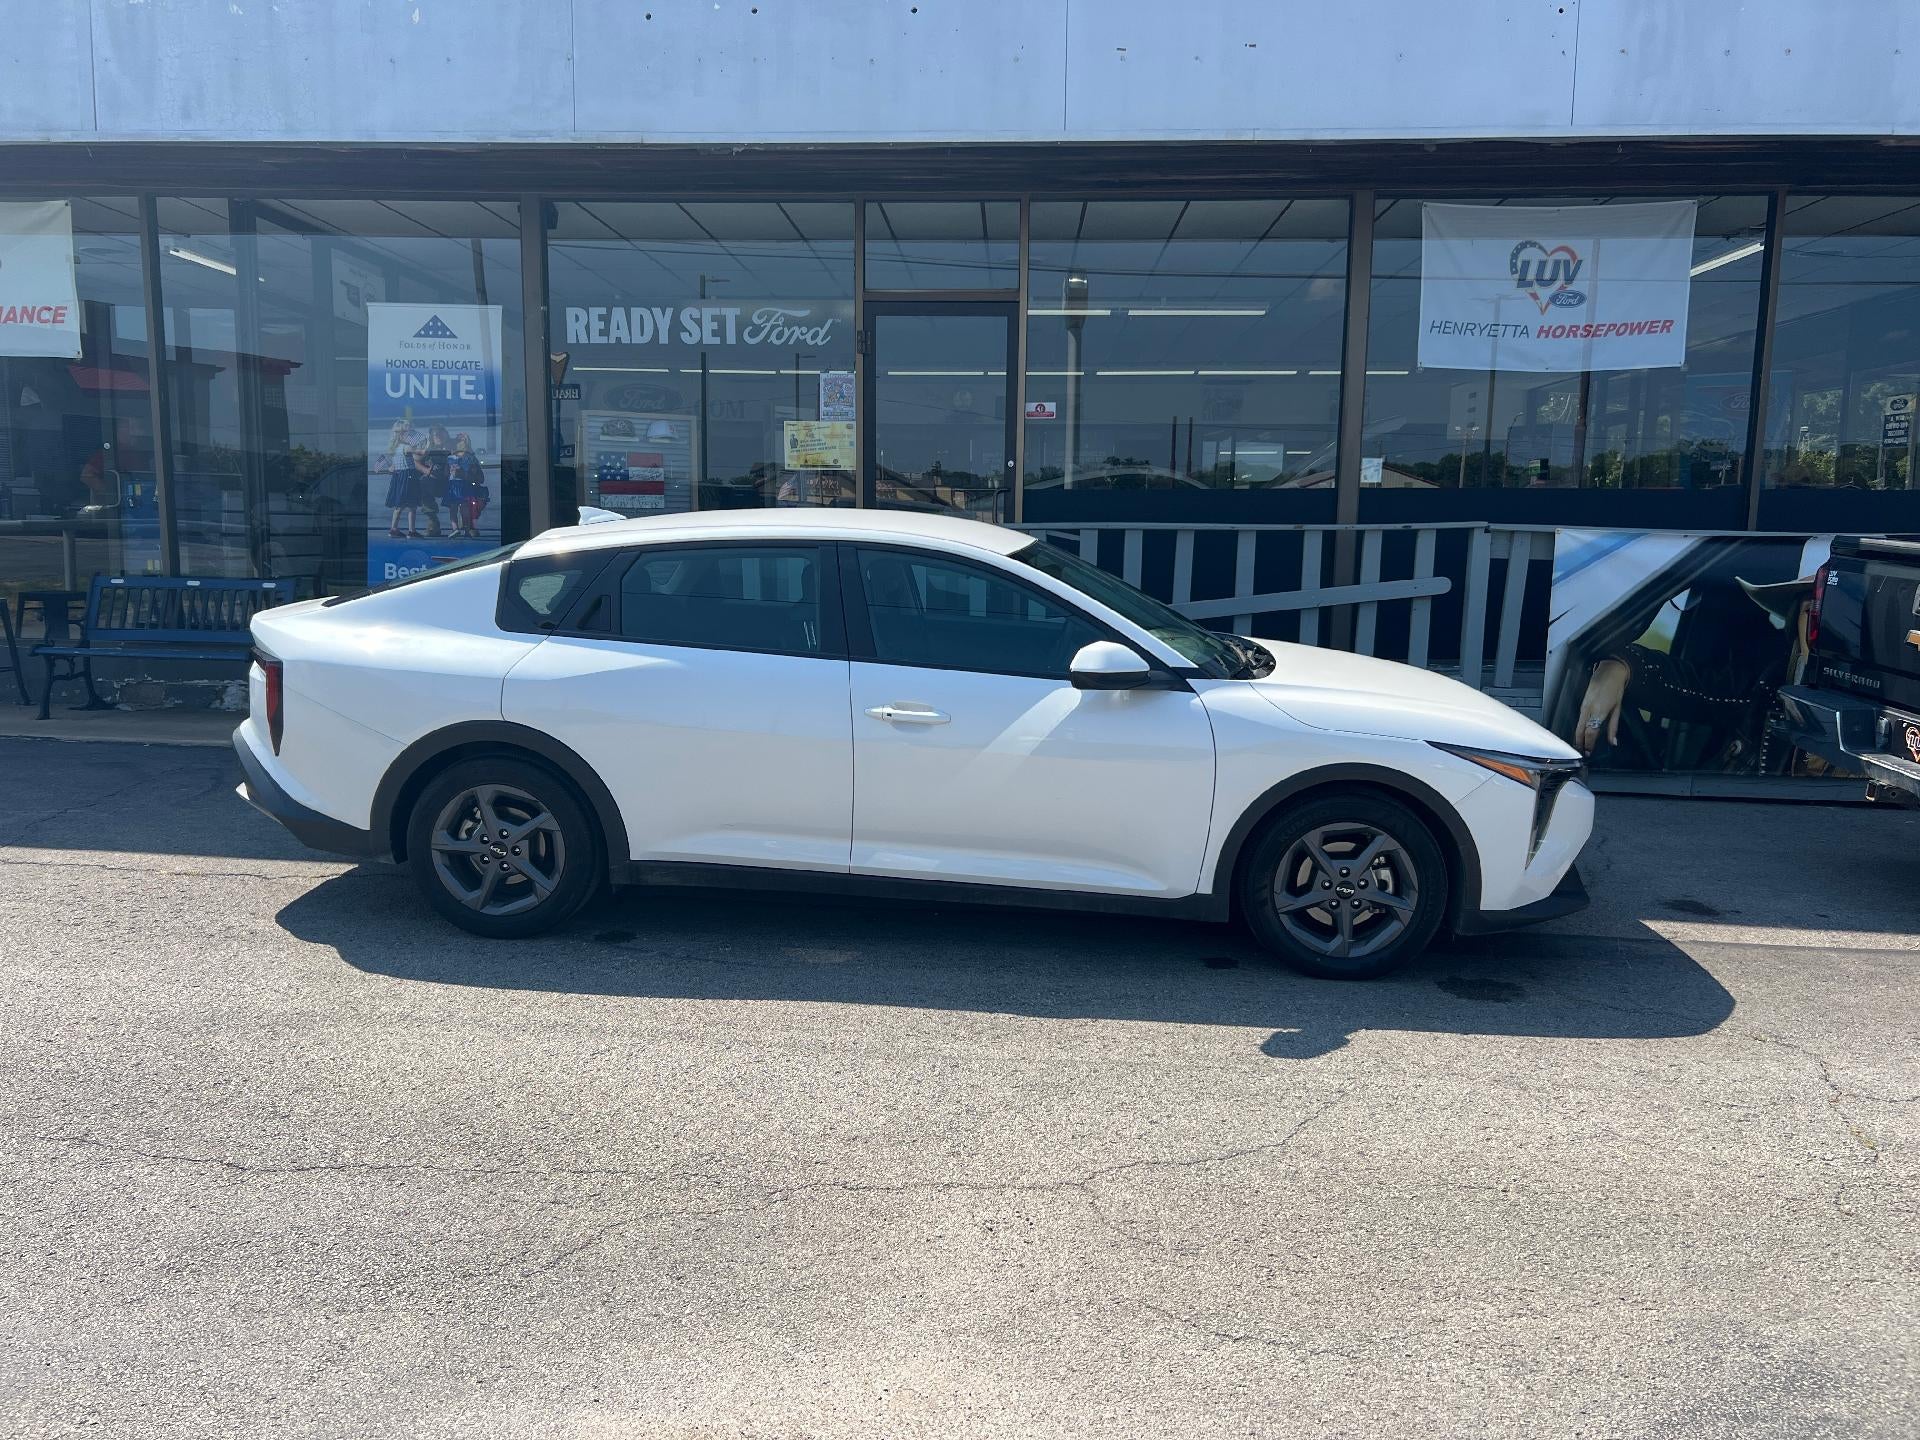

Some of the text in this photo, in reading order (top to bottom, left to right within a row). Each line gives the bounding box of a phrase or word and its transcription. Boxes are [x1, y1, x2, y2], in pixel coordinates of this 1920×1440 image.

[1516, 258, 1584, 289] LUV
[1555, 292, 1579, 305] Ford
[0, 305, 67, 324] ANCE
[566, 306, 833, 346] READY SET Ford
[1429, 319, 1674, 339] HENRYETTA HORSEPOWER
[385, 359, 483, 371] HONOR. EDUCATE.
[385, 372, 484, 401] UNITE.
[1823, 666, 1881, 689] SILVERADO
